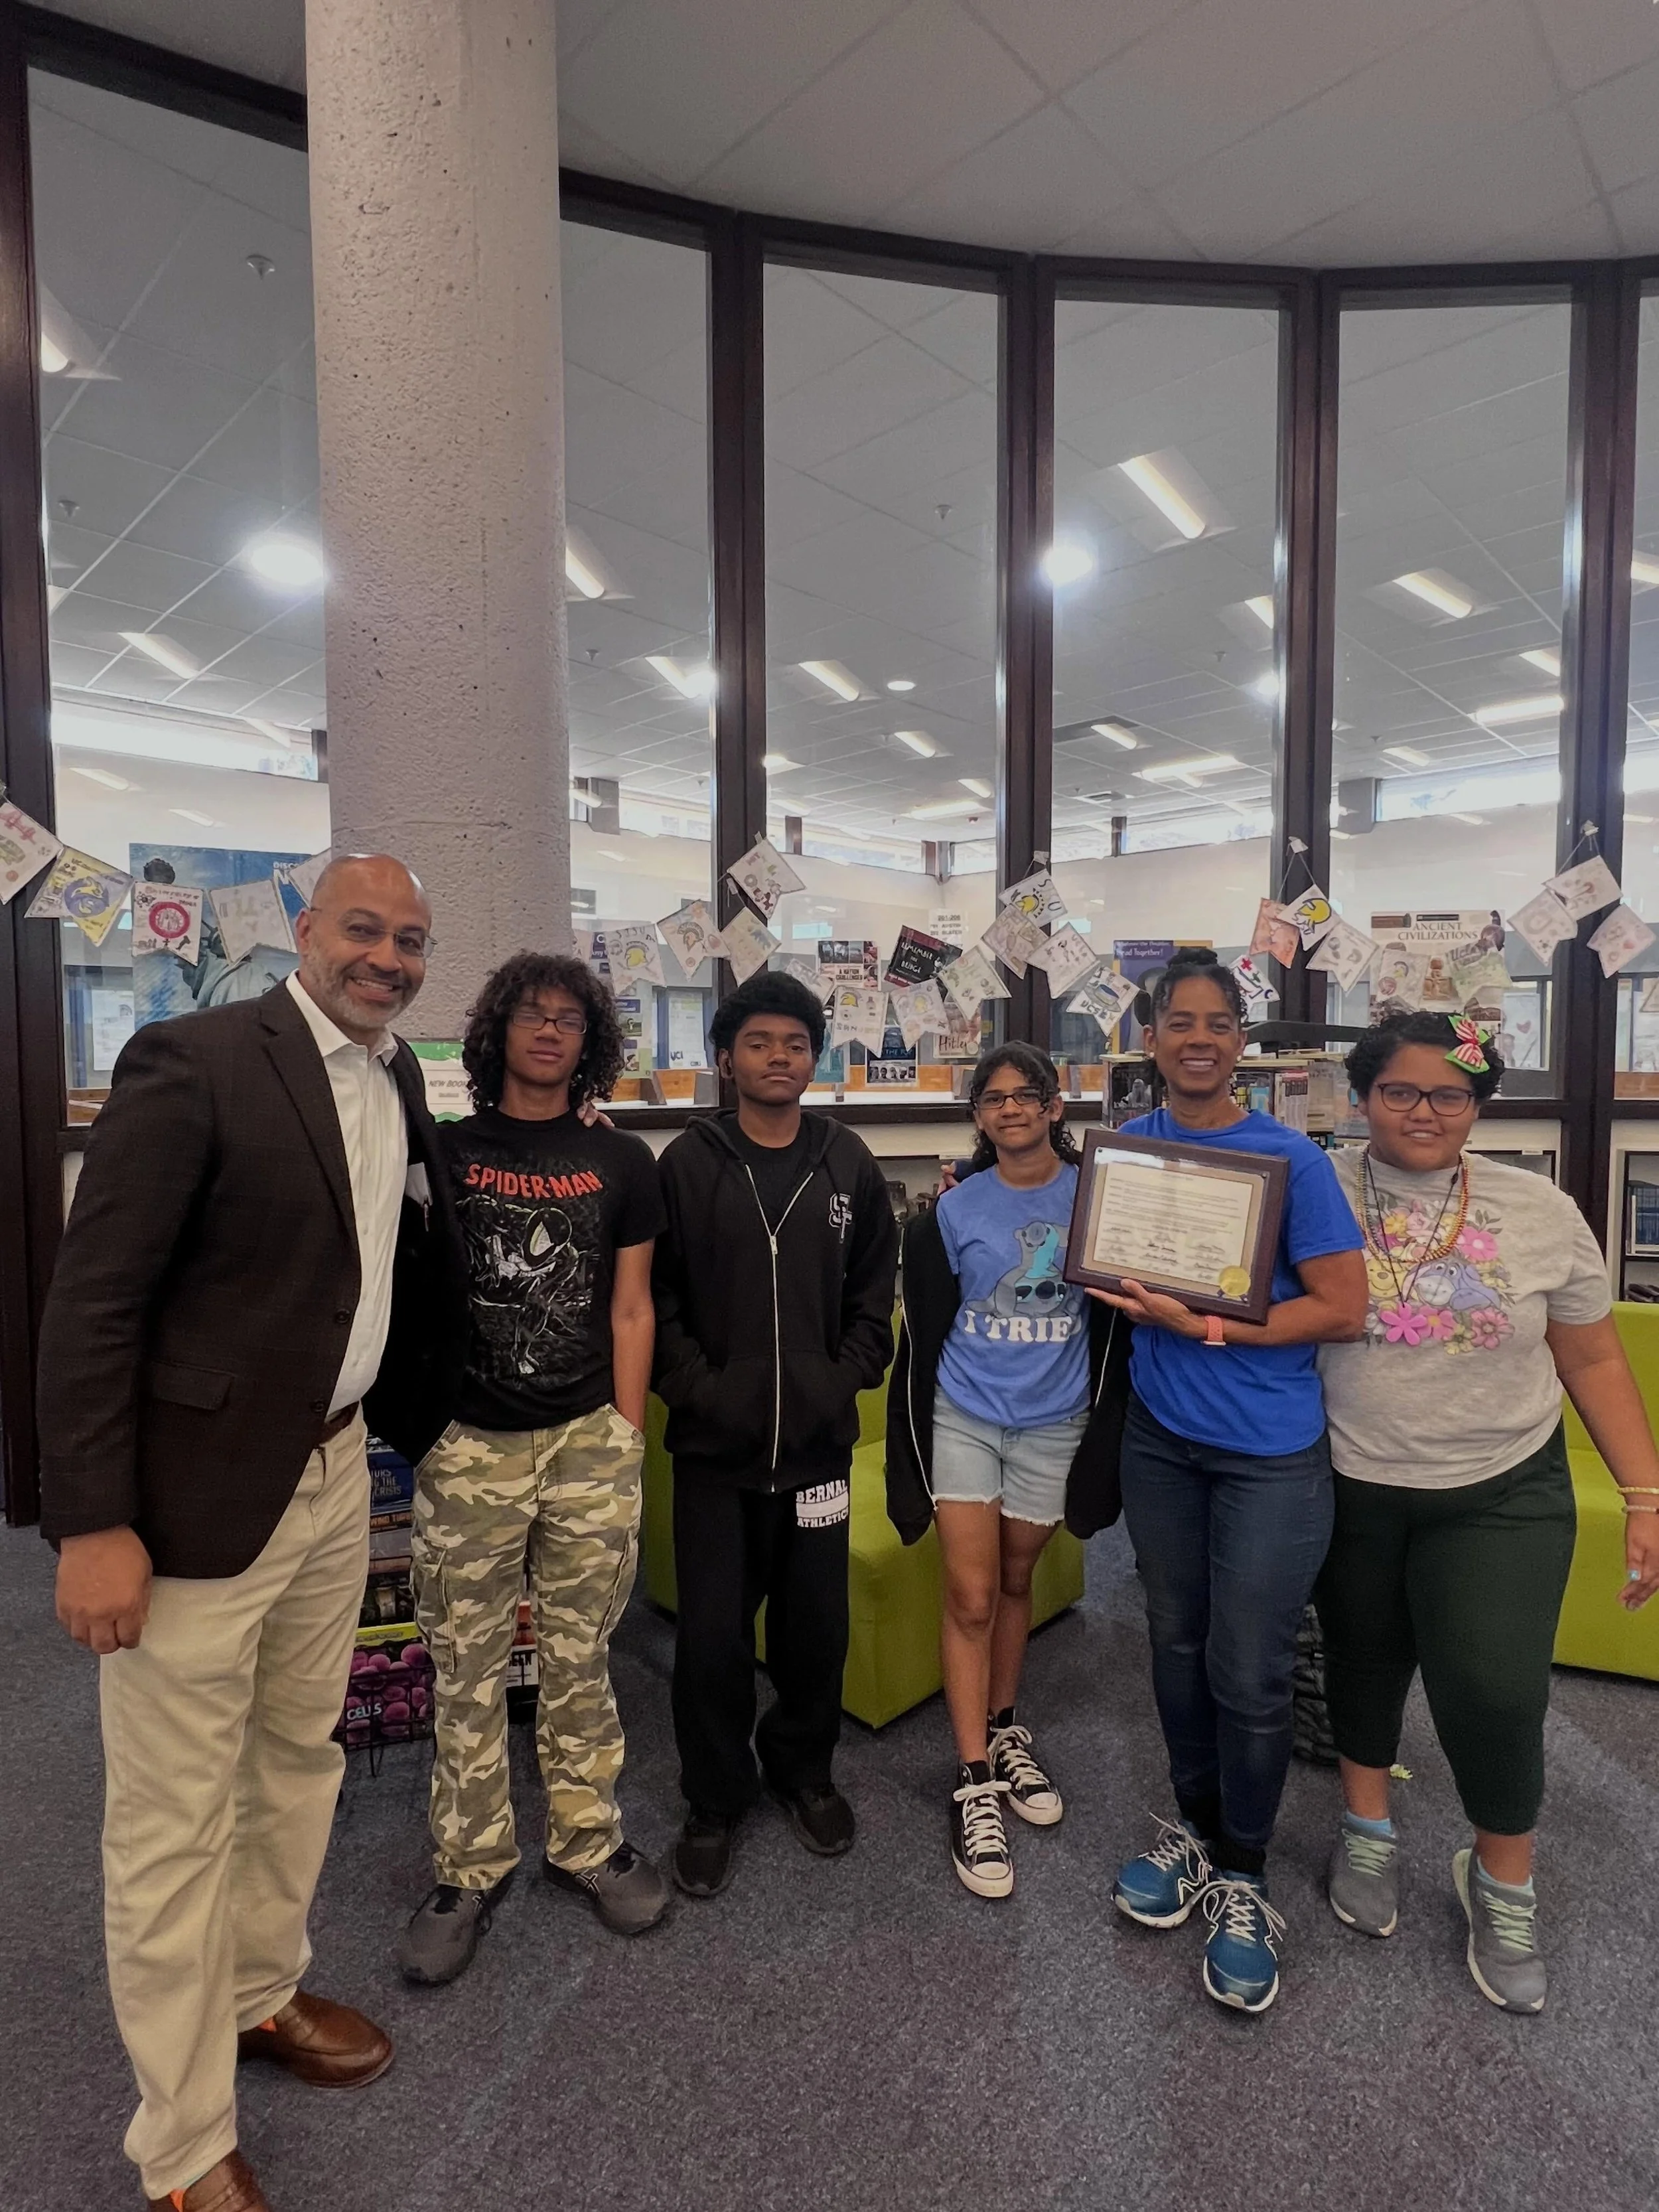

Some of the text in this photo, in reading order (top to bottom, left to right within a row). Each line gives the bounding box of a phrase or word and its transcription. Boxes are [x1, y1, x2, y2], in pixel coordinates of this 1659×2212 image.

[1398, 931, 1479, 941] CIVILIZATIONS
[964, 1309, 976, 1333] I
[796, 1479, 848, 1504] BERNAL
[797, 1507, 849, 1528] ATHLETIC
